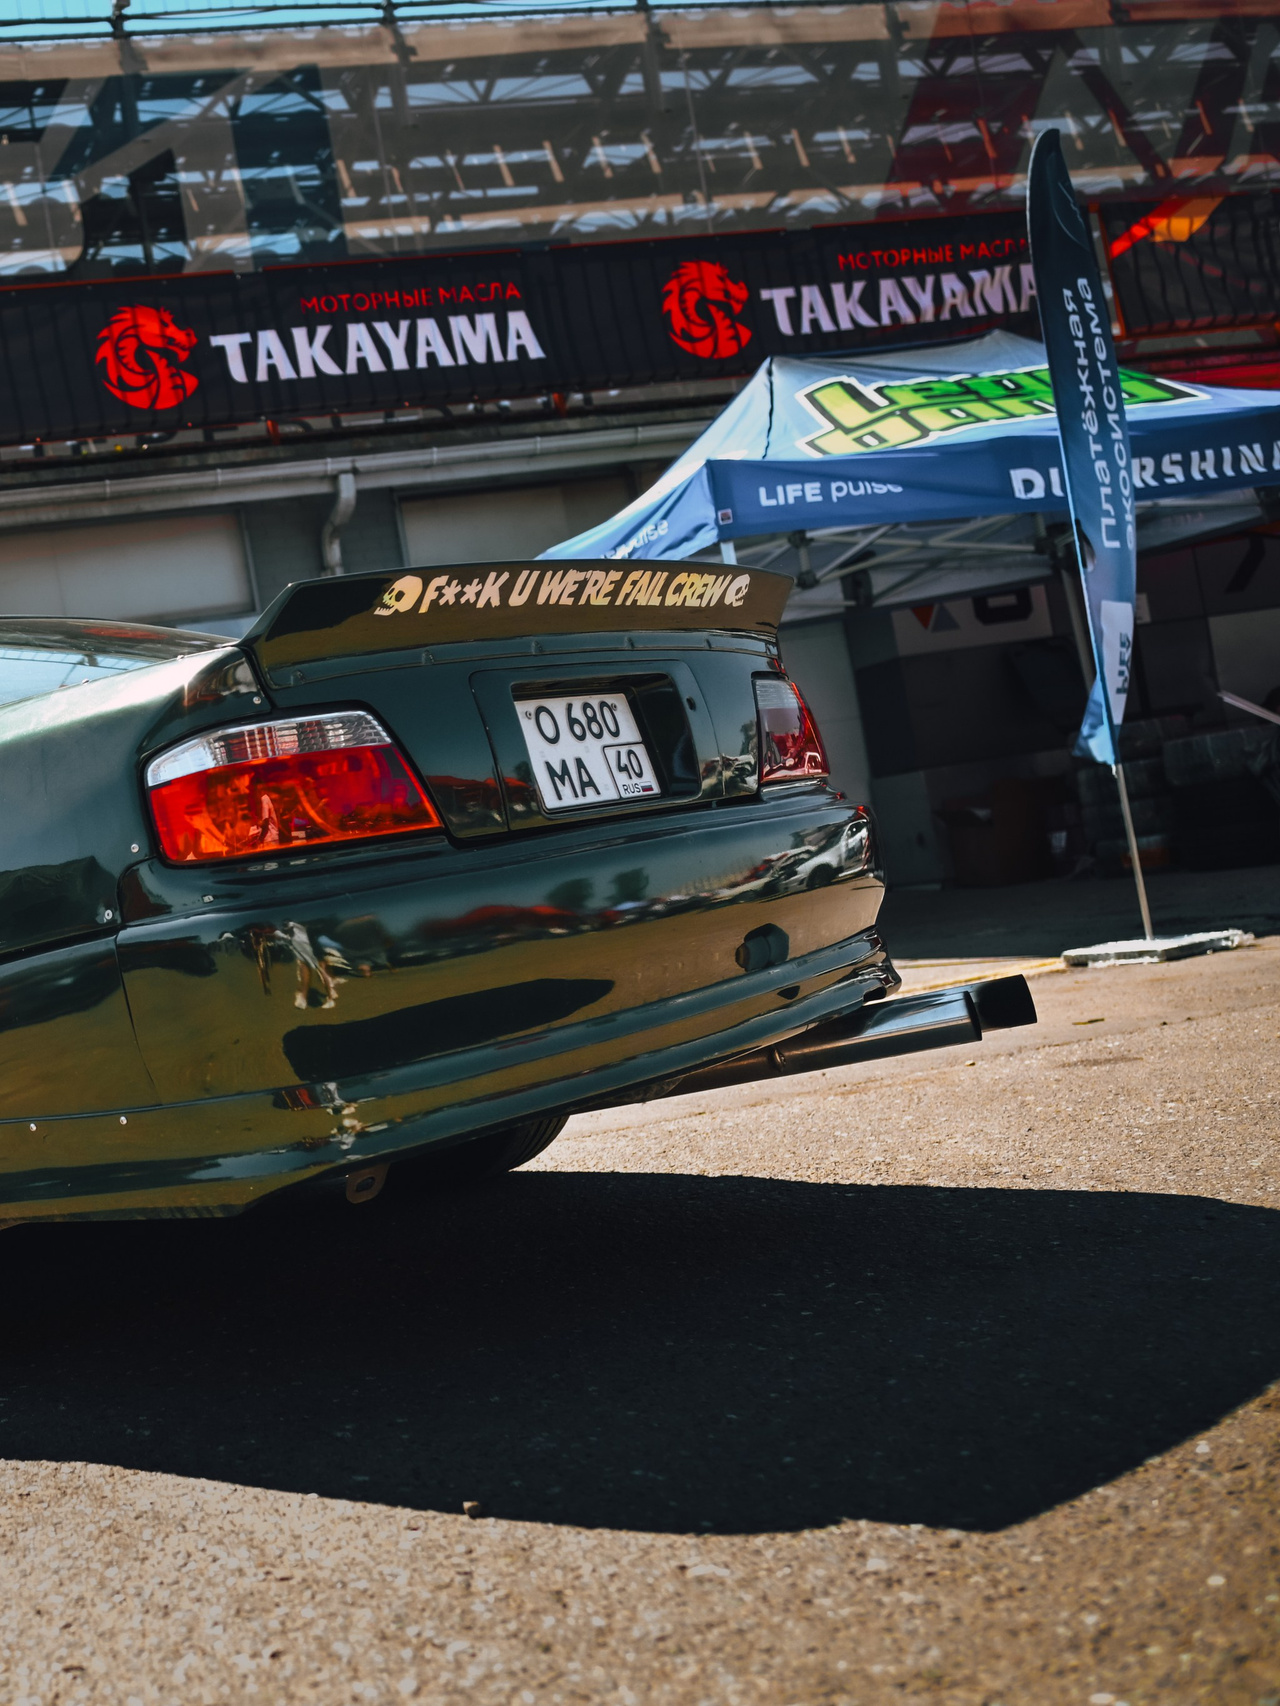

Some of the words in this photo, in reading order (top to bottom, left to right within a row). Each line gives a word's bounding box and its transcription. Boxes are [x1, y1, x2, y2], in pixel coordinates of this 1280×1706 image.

[837, 244, 955, 271] МОТОРНЫЕ
[300, 287, 434, 315] МОТОРНЫЕ
[438, 281, 522, 305] МАСЛА
[209, 309, 547, 384] TAKAYAMA
[1062, 287, 1121, 549] Платёжная
[1076, 277, 1135, 550] экосистема
[759, 481, 823, 507] LIFE
[509, 570, 541, 608] U
[536, 568, 623, 607] WE'RE
[616, 570, 672, 607] FAIL
[665, 572, 734, 608] CREW
[566, 700, 621, 741] 680
[616, 748, 644, 780] 40
[622, 783, 641, 795] RUS
